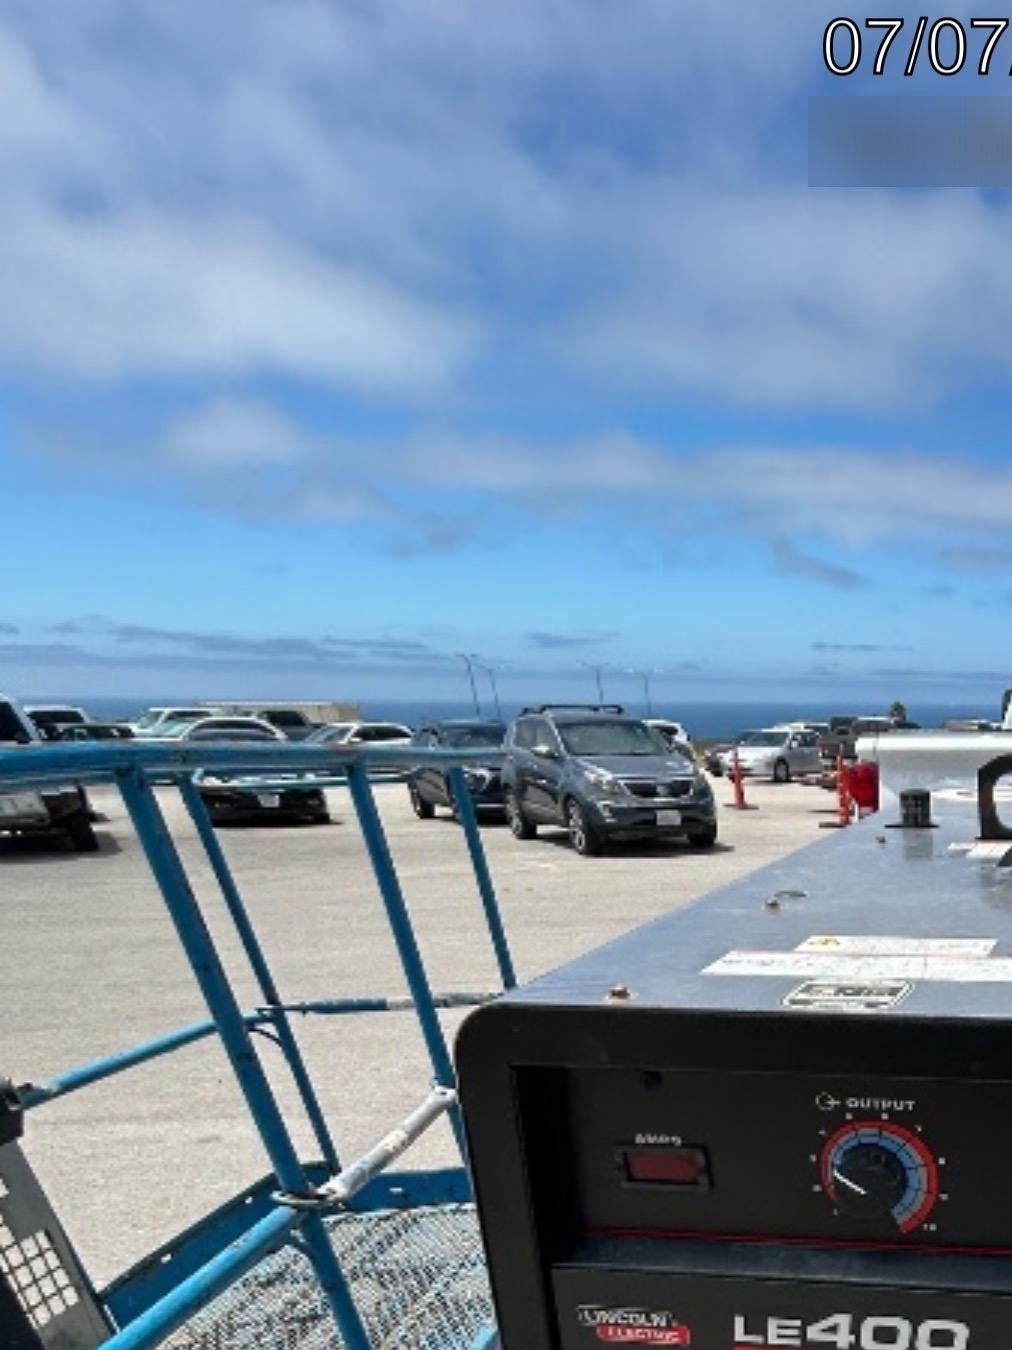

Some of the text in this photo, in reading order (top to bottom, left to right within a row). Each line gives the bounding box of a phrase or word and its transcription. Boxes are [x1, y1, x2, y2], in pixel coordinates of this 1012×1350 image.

[846, 1097, 915, 1111] OUTPUT
[580, 1308, 670, 1326] LINCOLN
[607, 1326, 681, 1342] ELECTRIC
